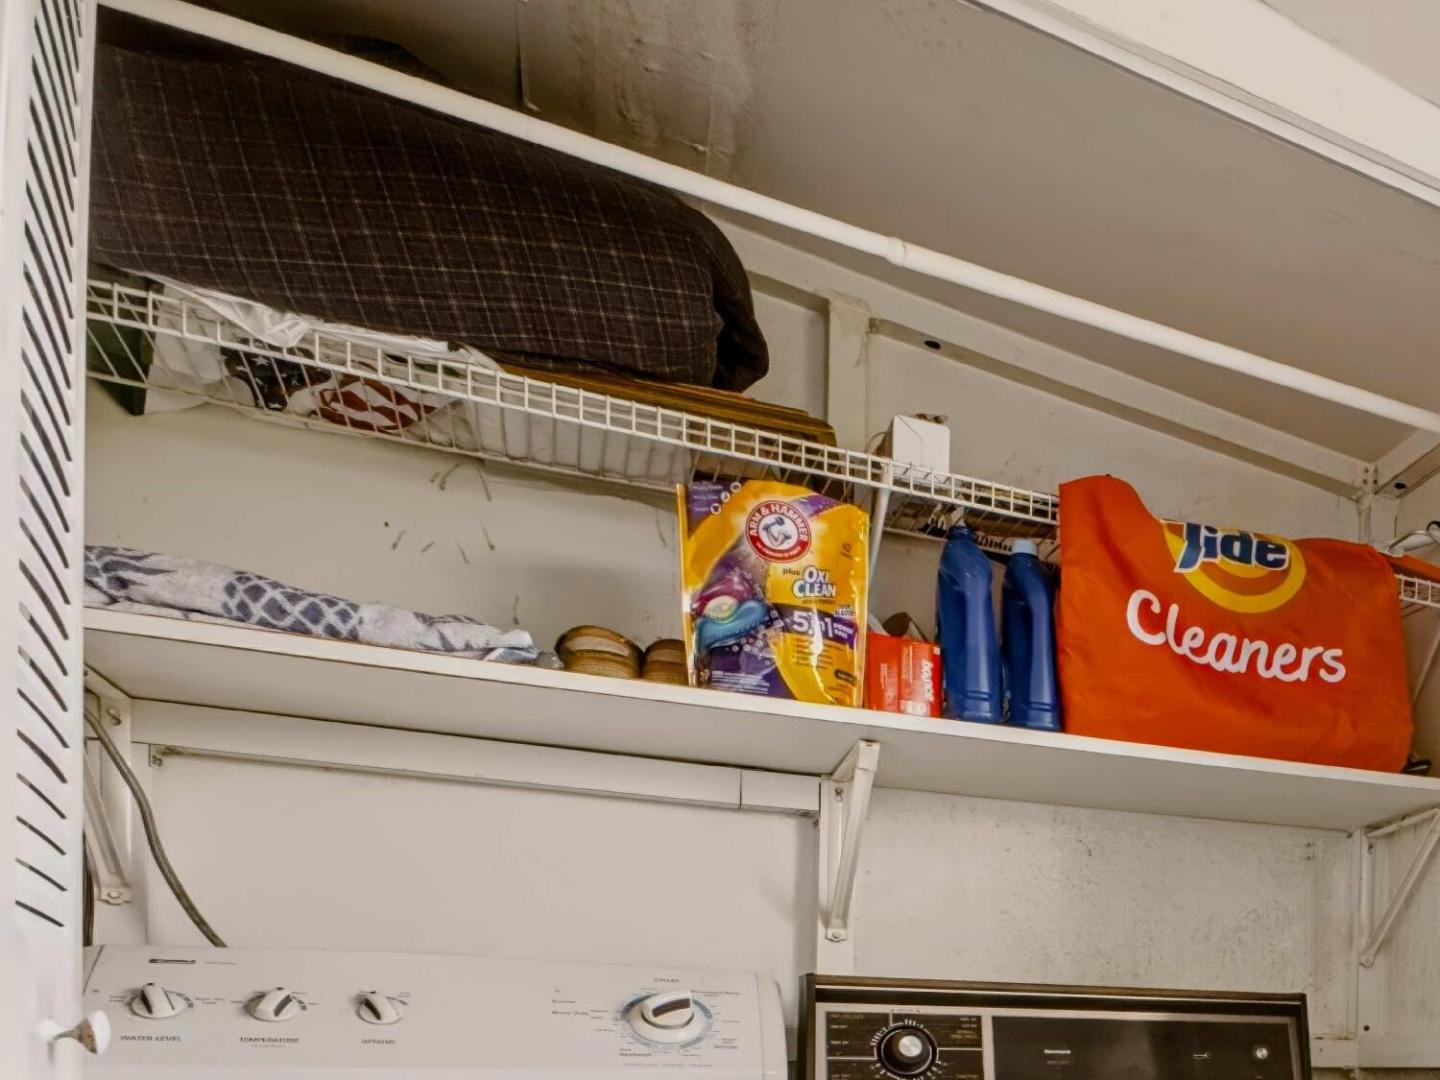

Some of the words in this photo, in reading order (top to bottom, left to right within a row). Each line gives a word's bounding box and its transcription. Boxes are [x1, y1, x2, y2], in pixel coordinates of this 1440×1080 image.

[749, 513, 762, 536] ARM
[760, 506, 770, 515] &
[769, 504, 809, 541] HAMMER
[782, 567, 801, 576] plus
[793, 579, 837, 598] CLEAN
[1125, 588, 1347, 684] Cleaners
